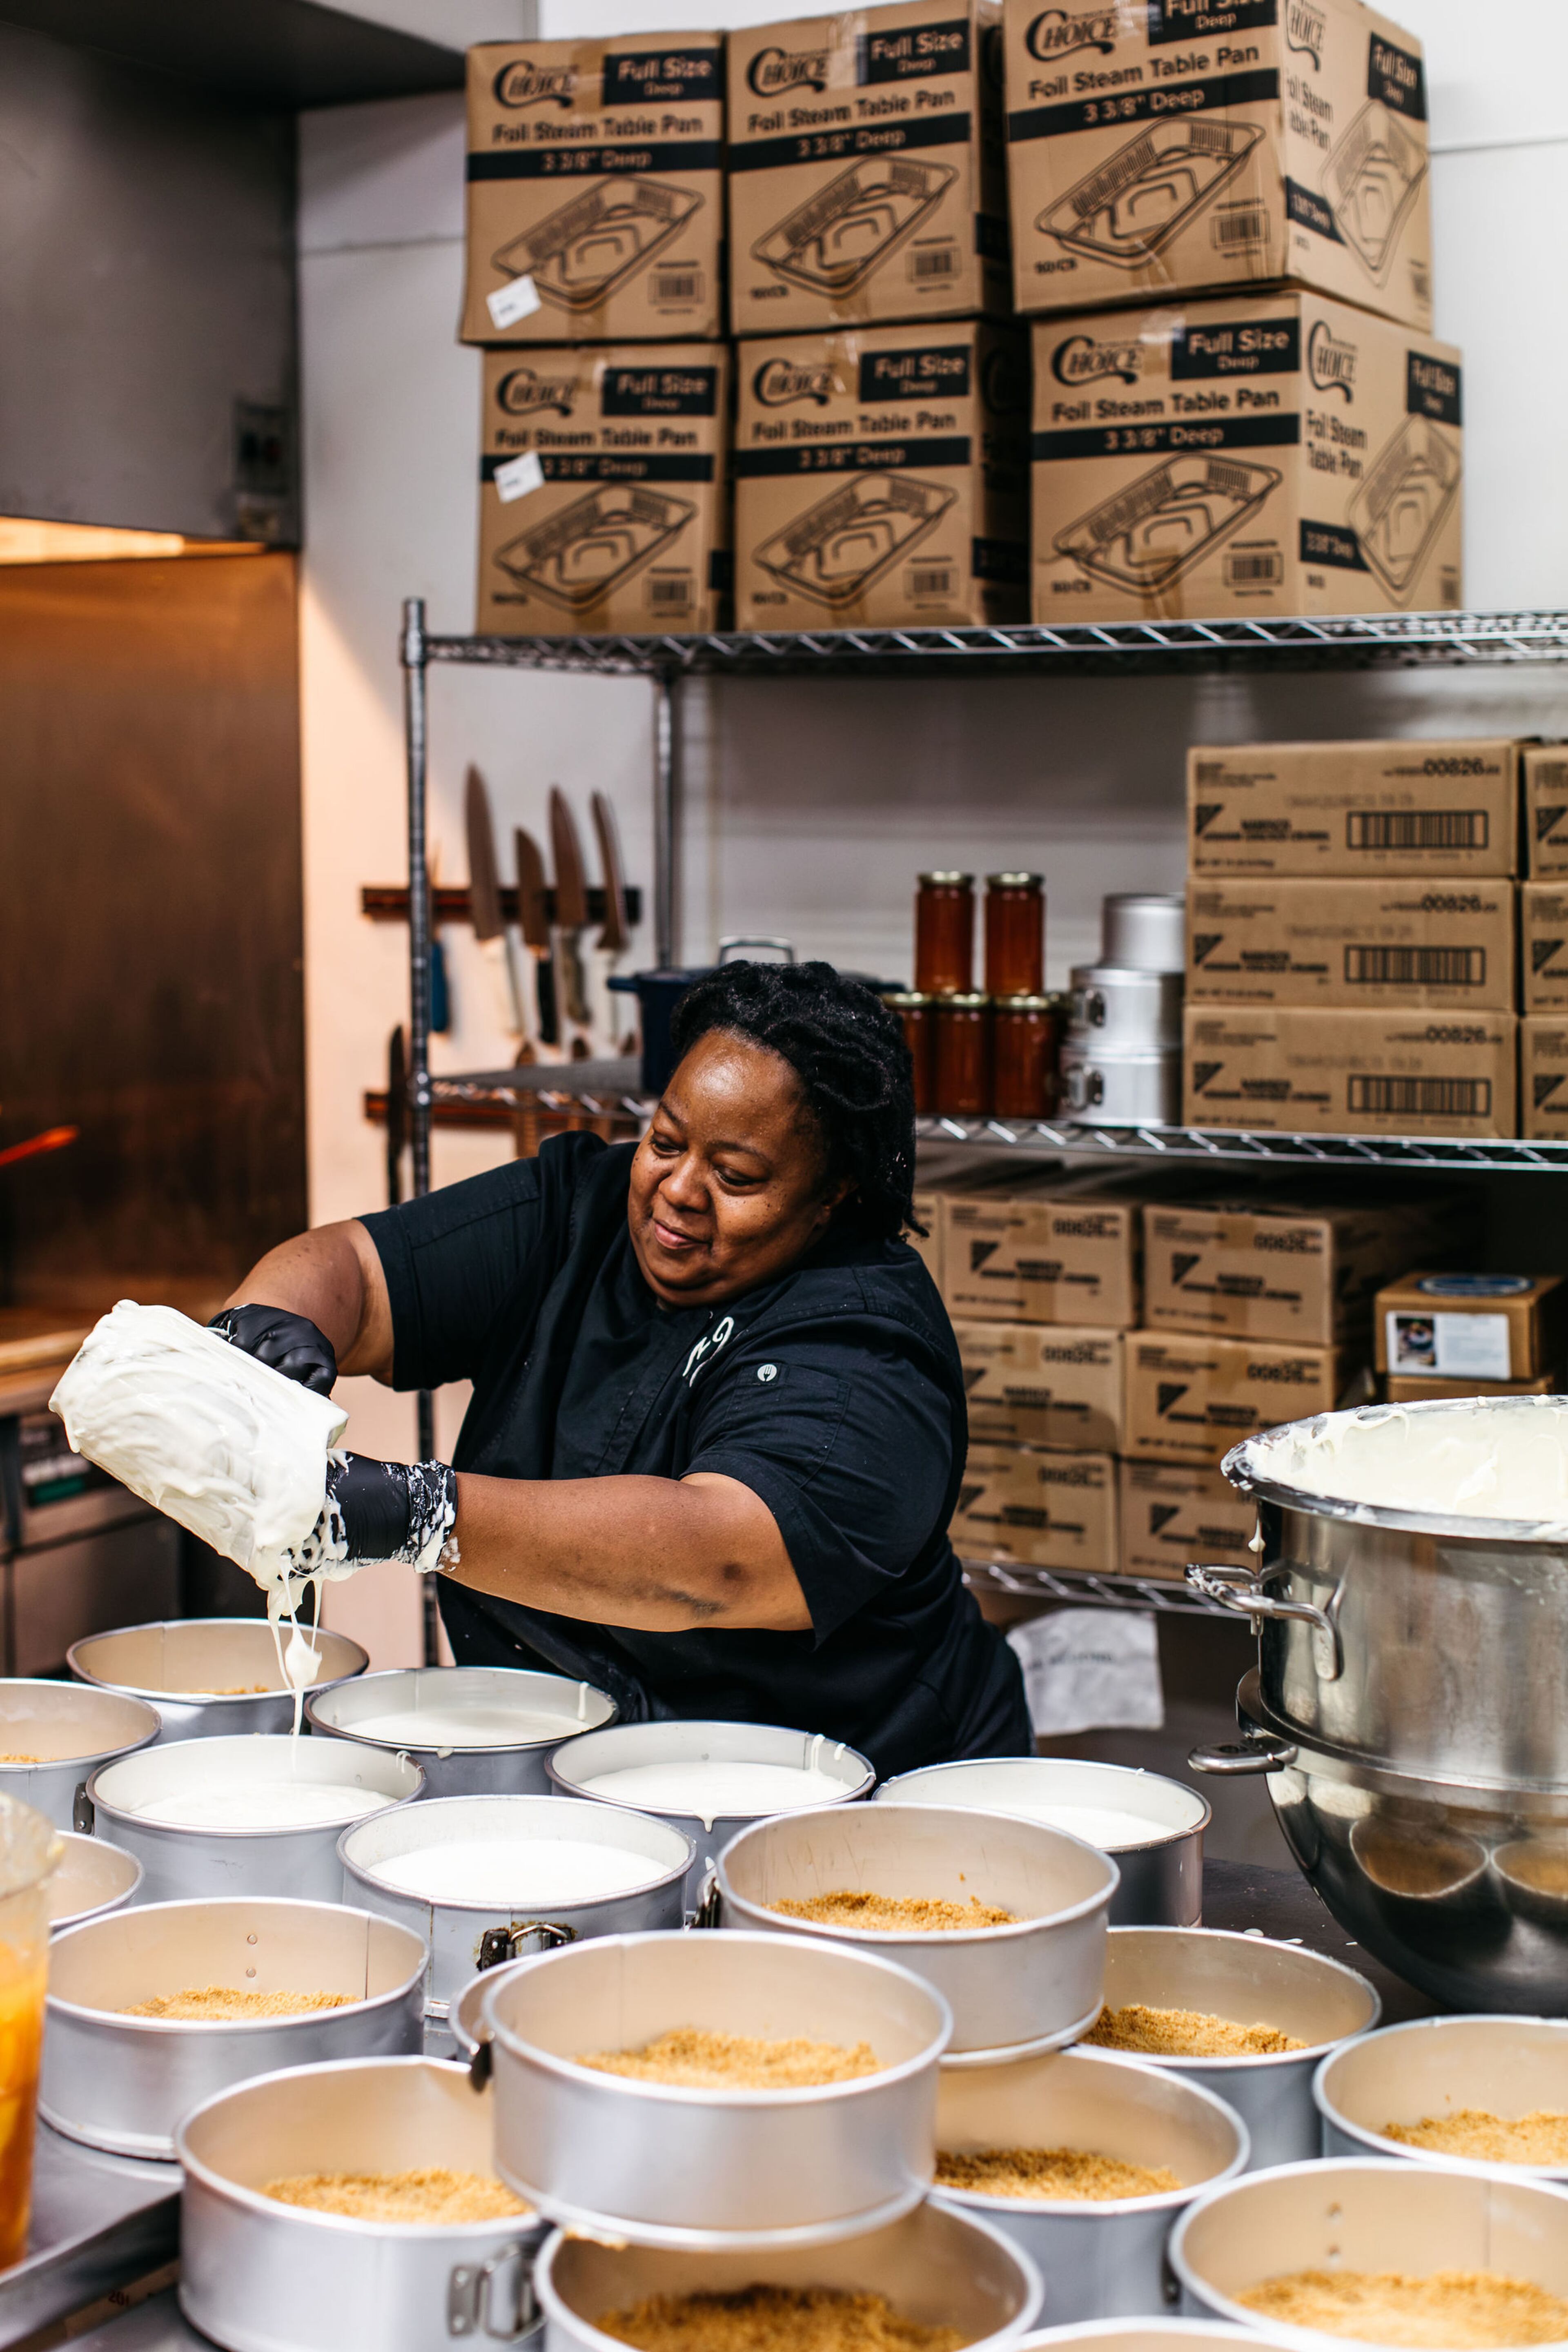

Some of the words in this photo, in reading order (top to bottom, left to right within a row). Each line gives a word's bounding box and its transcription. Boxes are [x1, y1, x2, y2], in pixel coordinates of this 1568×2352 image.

[1195, 13, 1236, 30] Deep
[871, 36, 912, 61] Full
[918, 31, 963, 54] Size
[618, 59, 659, 80] Full
[663, 56, 713, 78] Size
[1029, 76, 1069, 100] Foil
[1073, 67, 1143, 93] Steam
[1149, 53, 1209, 79] Table
[1217, 45, 1260, 67] Pan
[748, 112, 784, 133] Foil
[789, 105, 853, 127] Steam
[855, 94, 910, 117] Table
[915, 89, 956, 109] Pan
[1149, 89, 1205, 111] Deep
[491, 123, 528, 143] Foil
[534, 120, 598, 141] Steam
[604, 116, 657, 138] Table
[662, 114, 703, 135] Pan
[855, 130, 906, 150] Deep
[1188, 332, 1233, 356] Full
[1238, 328, 1290, 352] Size
[874, 358, 916, 379] Full
[920, 354, 966, 375] Size
[1217, 355, 1259, 371] Deep
[617, 374, 657, 395] Full
[661, 372, 708, 394] Size
[1052, 400, 1091, 422] Foil
[1096, 398, 1165, 420] Steam
[1170, 391, 1230, 412] Table
[1236, 388, 1280, 409] Pan
[657, 427, 698, 446] Pan
[752, 421, 788, 441] Foil
[791, 417, 853, 439] Steam
[858, 414, 911, 434] Table
[916, 411, 956, 430] Pan
[1169, 425, 1224, 447] Deep
